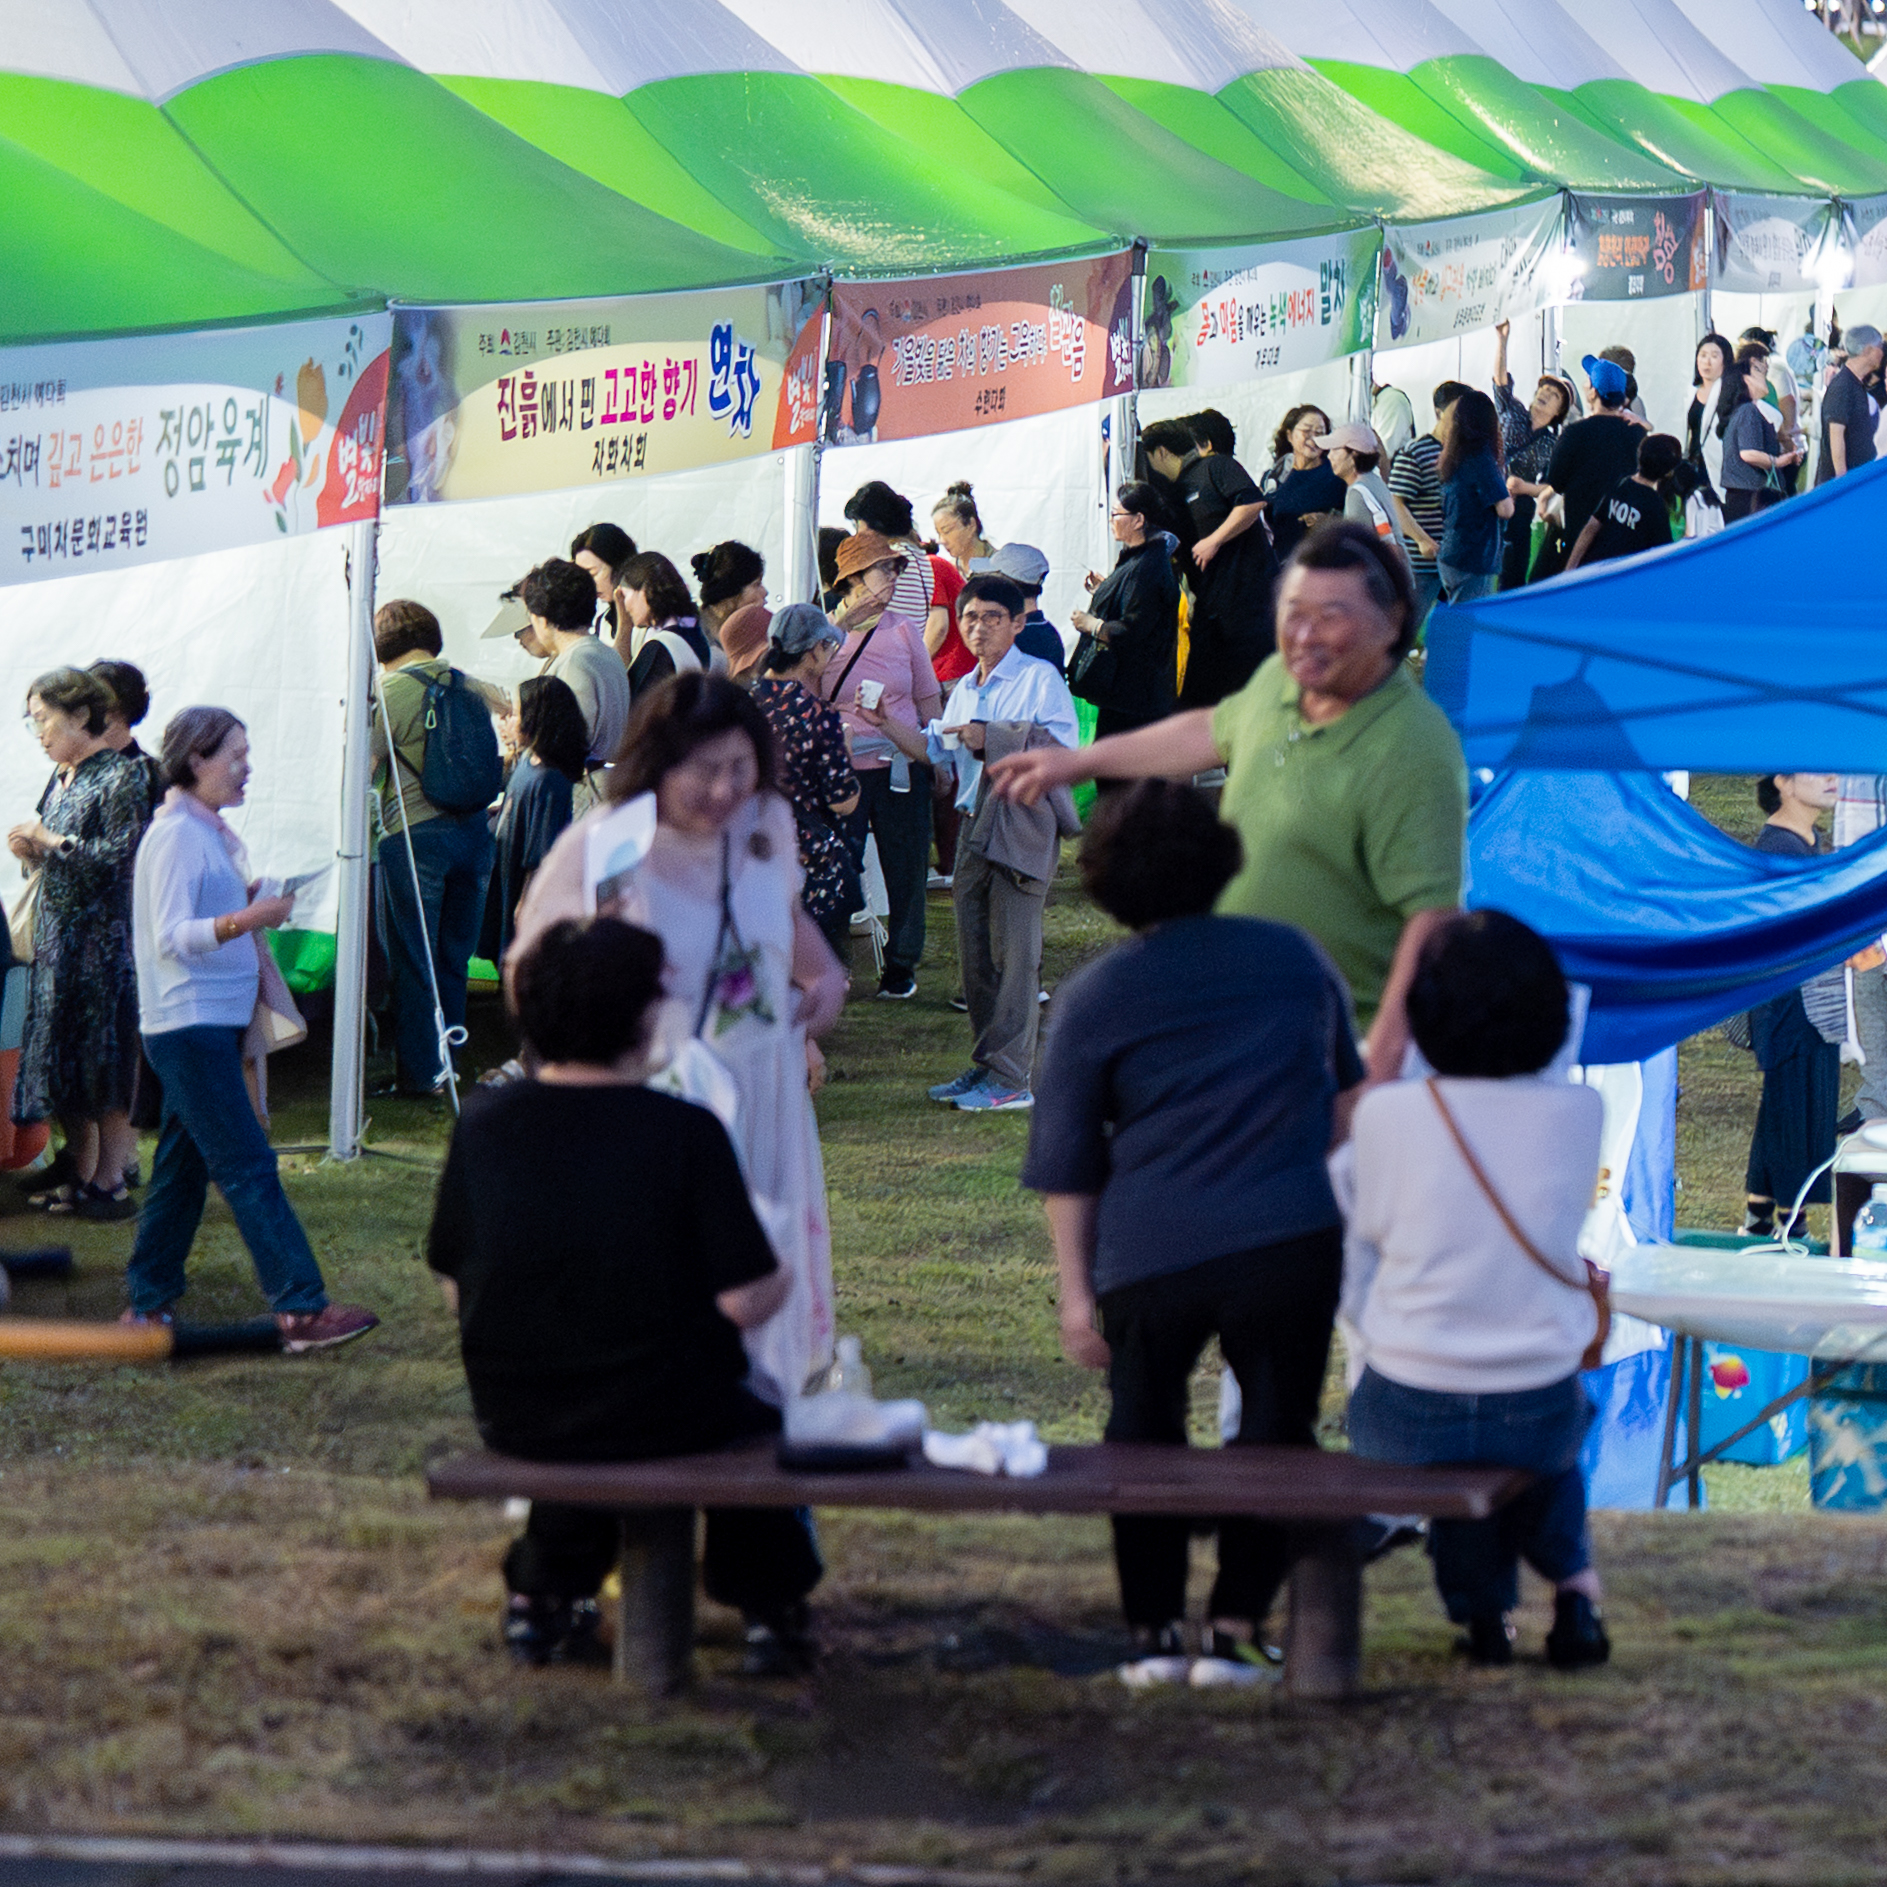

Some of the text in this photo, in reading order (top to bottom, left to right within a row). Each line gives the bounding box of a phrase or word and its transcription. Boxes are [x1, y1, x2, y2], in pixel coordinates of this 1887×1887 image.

[1220, 297, 1244, 343] 마음을
[498, 358, 698, 442] 진흙에서 핀 고고한 향기
[708, 318, 762, 439] 연차
[48, 429, 82, 488] 깊고
[90, 416, 144, 483] 은은한
[156, 393, 270, 498] 정암육계
[21, 509, 148, 562] 구미차문화교육원
[1608, 498, 1641, 530] KOR
